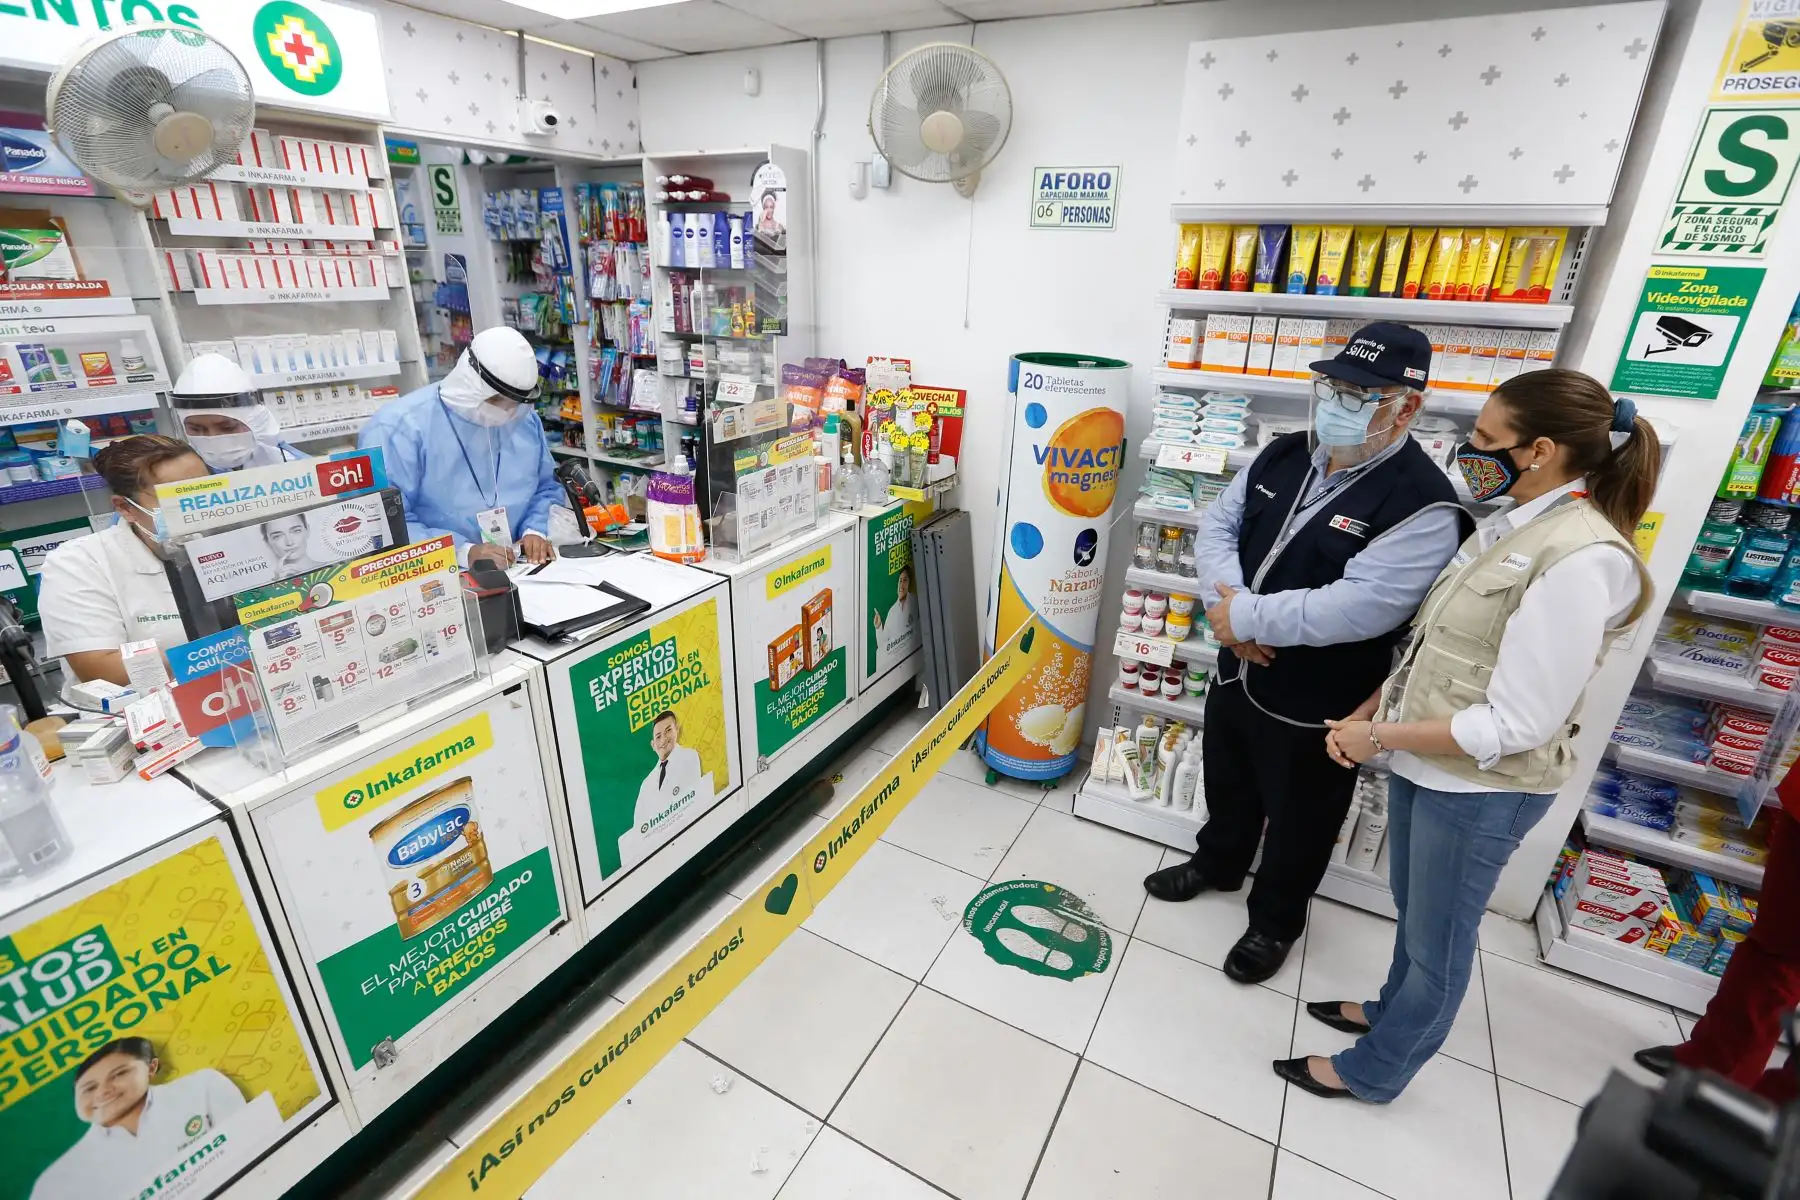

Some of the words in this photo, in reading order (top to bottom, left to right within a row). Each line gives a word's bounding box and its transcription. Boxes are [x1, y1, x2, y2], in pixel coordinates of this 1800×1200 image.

[1723, 76, 1800, 91] PROSEG
[4, 146, 45, 158] Panadol
[1705, 115, 1789, 197] S
[20, 176, 55, 185] FIEBRE
[248, 171, 297, 182] INKAFARMA
[1040, 172, 1111, 190] AFORO
[434, 167, 454, 206] S
[1040, 191, 1078, 199] CAPACIDAD
[1037, 202, 1055, 218] 06
[1062, 206, 1111, 224] PERSONAS
[1684, 216, 1712, 225] ZONA
[1716, 217, 1758, 226] SEGURA
[1694, 225, 1710, 233] EN
[1713, 225, 1743, 234] CASO
[257, 227, 304, 235] INKAFARMA
[1684, 233, 1698, 241] DE
[1702, 234, 1747, 243] SISMOS
[0, 283, 45, 292] SCULAR
[1679, 282, 1719, 293] Zona
[1647, 292, 1748, 307] Videovigilada
[23, 324, 55, 335] teva
[1346, 344, 1381, 363] Salud
[1377, 343, 1386, 352] de
[294, 372, 337, 382] INKAFARMA
[1024, 372, 1043, 390] 20
[1045, 375, 1084, 387] Tabletas
[913, 392, 955, 403] OVECHA!
[1045, 384, 1106, 395] efervescentes
[939, 408, 961, 416] BAJOS
[1182, 452, 1192, 463] 4
[330, 463, 364, 488] oh!
[179, 484, 267, 513] REALIZA
[270, 472, 313, 496] AQUÍ
[183, 481, 223, 493] Inkafarma
[184, 514, 199, 524] EL
[200, 507, 235, 521] PAGO
[237, 503, 253, 513] DE
[255, 499, 269, 509] TU
[271, 490, 316, 506] TARJETA
[874, 515, 913, 545] EXPERTOS
[199, 551, 224, 563] NUEVO
[875, 540, 886, 556] EN
[358, 551, 409, 576] ¡PRECIOS
[410, 540, 443, 558] BAJOS
[1745, 552, 1782, 563] LISTERINE
[361, 575, 379, 585] QUE
[380, 558, 424, 579] ALIVIAN
[379, 581, 391, 589] TU
[391, 559, 444, 585] BOLSILLO!
[783, 558, 825, 586] Inkafarma
[1065, 569, 1093, 579] Sabor
[253, 599, 295, 617] Inkafarma
[1043, 596, 1069, 606] Libre
[136, 614, 156, 623] Inka
[157, 613, 182, 621] Farm
[417, 604, 435, 619] 35
[1044, 607, 1049, 616] y
[441, 624, 457, 638] 16
[1695, 627, 1745, 644] Doctor
[187, 636, 245, 661] COMPRA
[608, 640, 649, 669] SOMOS
[1135, 642, 1149, 655] 16
[187, 654, 221, 676] AQUÍ
[268, 658, 291, 675] 45
[589, 640, 675, 698] EXPERTOS
[1691, 652, 1743, 670] Doctor
[594, 687, 618, 712] EN
[622, 657, 675, 697] SALUD
[679, 657, 685, 667] Y
[687, 649, 700, 664] EN
[629, 660, 703, 712] CUIDADO
[766, 702, 777, 714] EL
[777, 681, 805, 706] MEJOR
[805, 659, 838, 687] CUIDADO
[631, 672, 711, 730] PERSONAL
[776, 699, 797, 720] PARA
[798, 690, 808, 703] TU
[808, 675, 828, 697] BEBÉ
[790, 688, 825, 720] PRECIOS
[930, 729, 947, 750] nos
[947, 684, 986, 732] cuidamos
[986, 656, 1011, 688] todos!
[792, 704, 818, 730] BAJOS
[365, 735, 477, 800] Inkafarma
[649, 790, 696, 828] Inkafarma
[828, 775, 900, 860] Inkafarma
[397, 815, 464, 861] BabyLac
[412, 882, 422, 899] 3
[1592, 878, 1634, 894] Colgate
[967, 905, 978, 919] nos
[975, 885, 1010, 907] cuidamos
[1009, 882, 1039, 890] todos!
[1581, 904, 1622, 920] Colgate
[360, 973, 389, 996] EL
[388, 922, 455, 977] MEJOR
[457, 870, 533, 927] CUIDADO
[124, 949, 142, 967] Y
[152, 926, 188, 955] EN
[388, 953, 440, 995] PARA
[440, 931, 467, 956] TU
[467, 897, 513, 939] BEBÉ
[413, 981, 426, 996] A
[425, 918, 508, 985] PRECIOS
[434, 943, 497, 997] BAJOS
[467, 1126, 524, 1192] ¡Así
[527, 1085, 576, 1135] nos
[579, 985, 686, 1088] cuidamos
[687, 927, 745, 990] todos!
